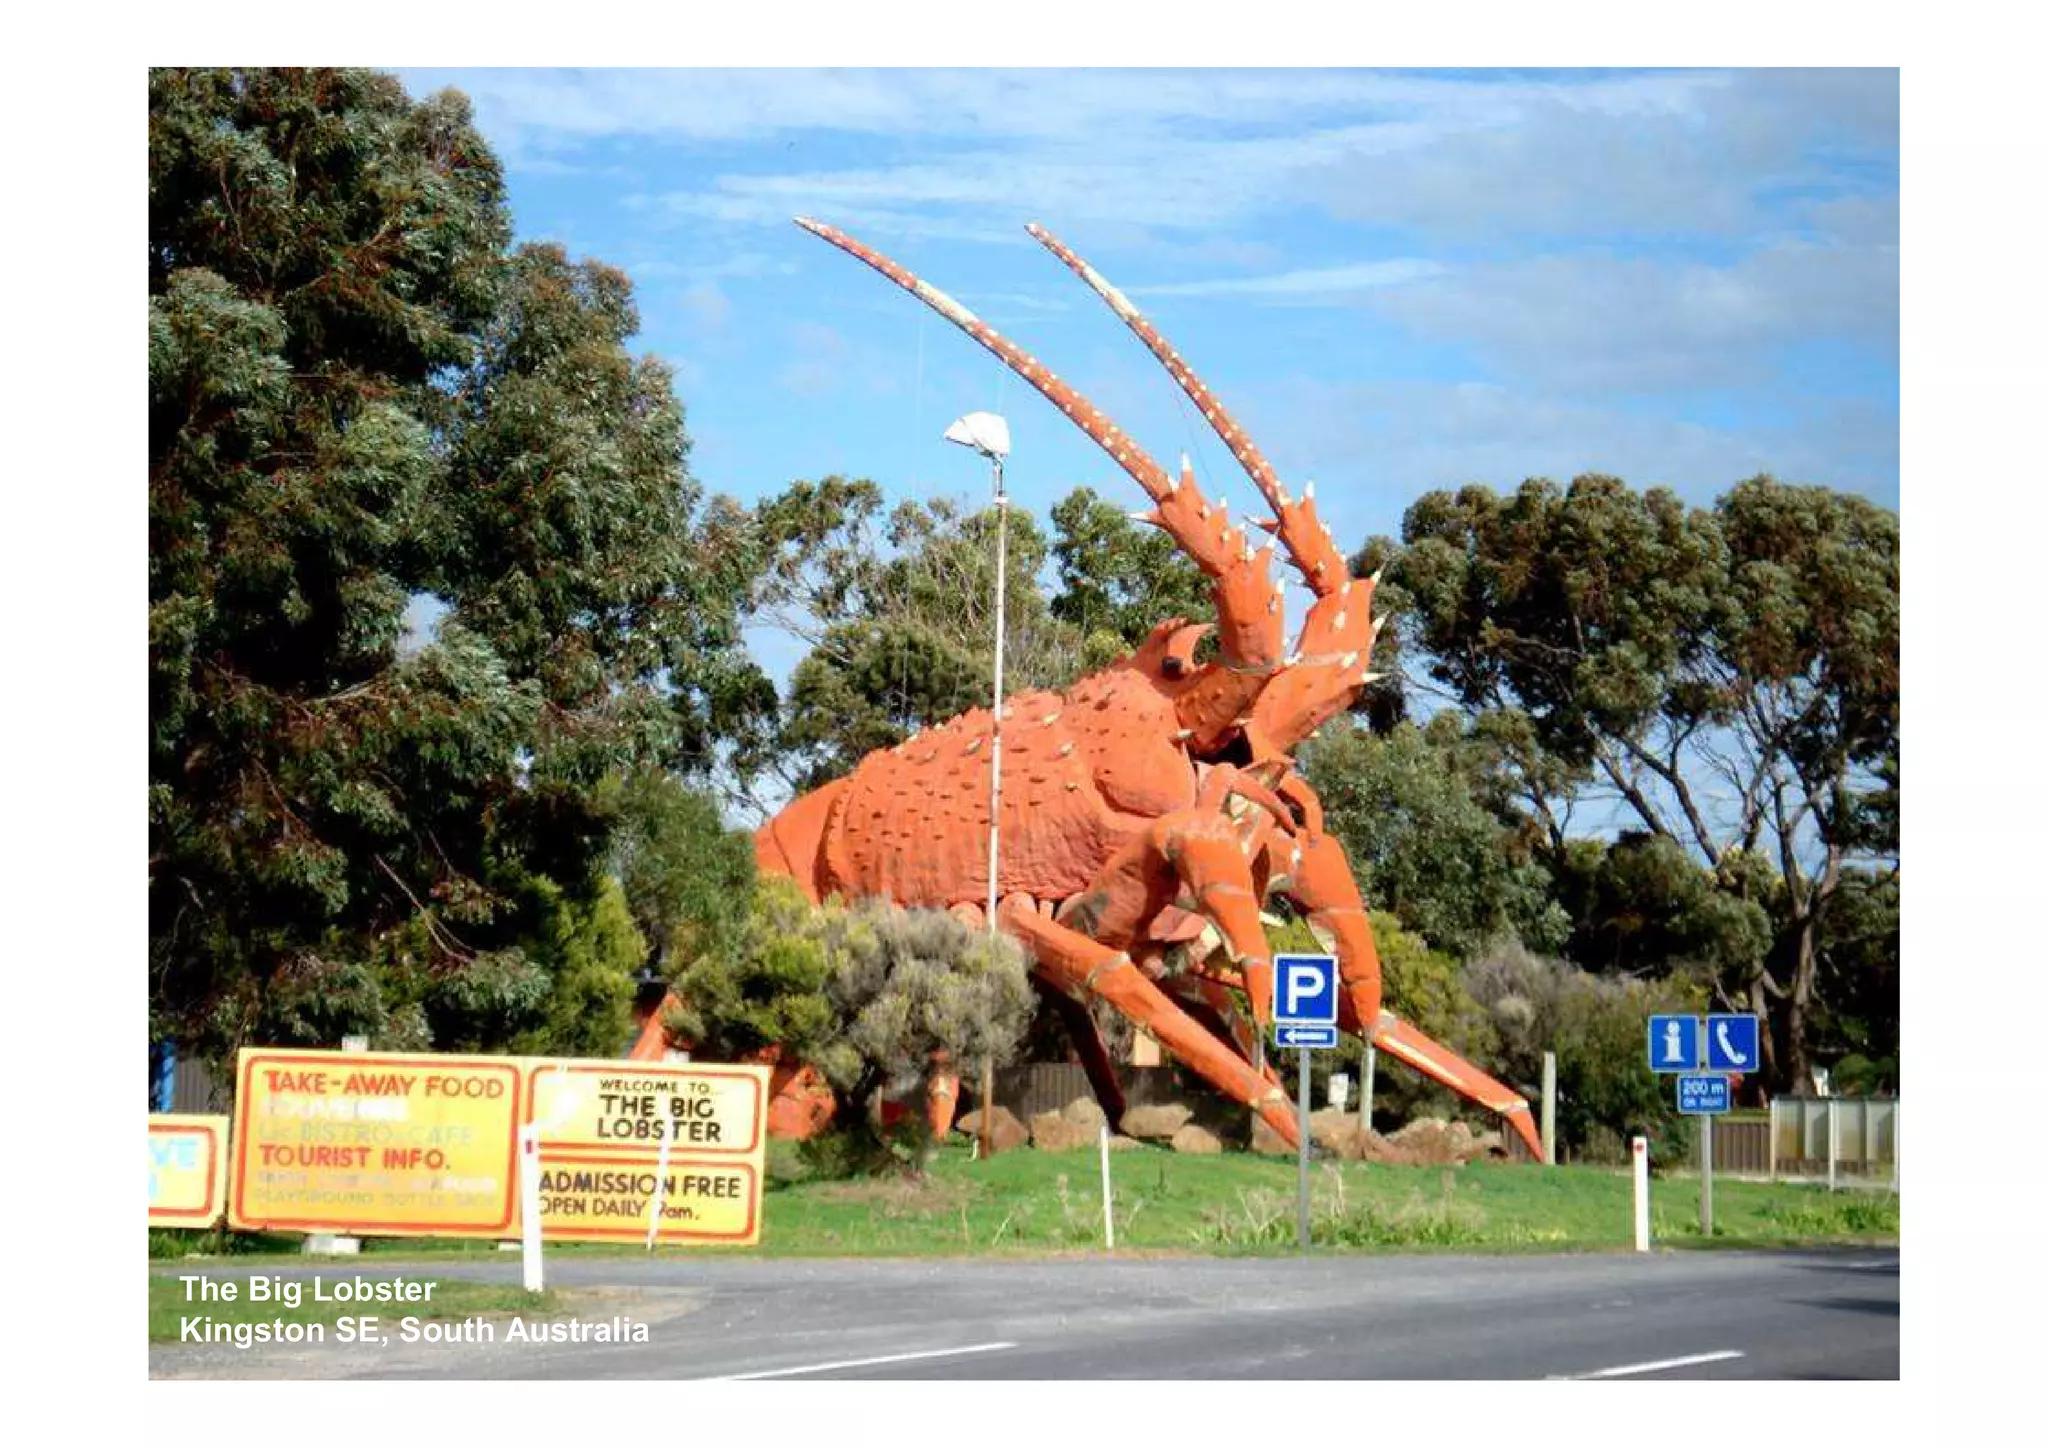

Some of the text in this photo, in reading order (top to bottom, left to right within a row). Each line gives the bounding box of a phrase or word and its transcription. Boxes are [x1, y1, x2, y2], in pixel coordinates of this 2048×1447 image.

[1288, 966, 1325, 1014] P
[262, 1069, 505, 1099] TAKE-AWAY FOOD
[599, 1078, 678, 1093] WELCOME
[1711, 1083, 1724, 1095] m
[599, 1094, 715, 1119] THE BIG
[597, 1117, 721, 1142] LOBSTER
[259, 1143, 452, 1171] TOURIST INFO.
[538, 1170, 741, 1199] ADMISSION FREE
[539, 1196, 587, 1216] OPEN
[592, 1198, 646, 1218] DAILY
